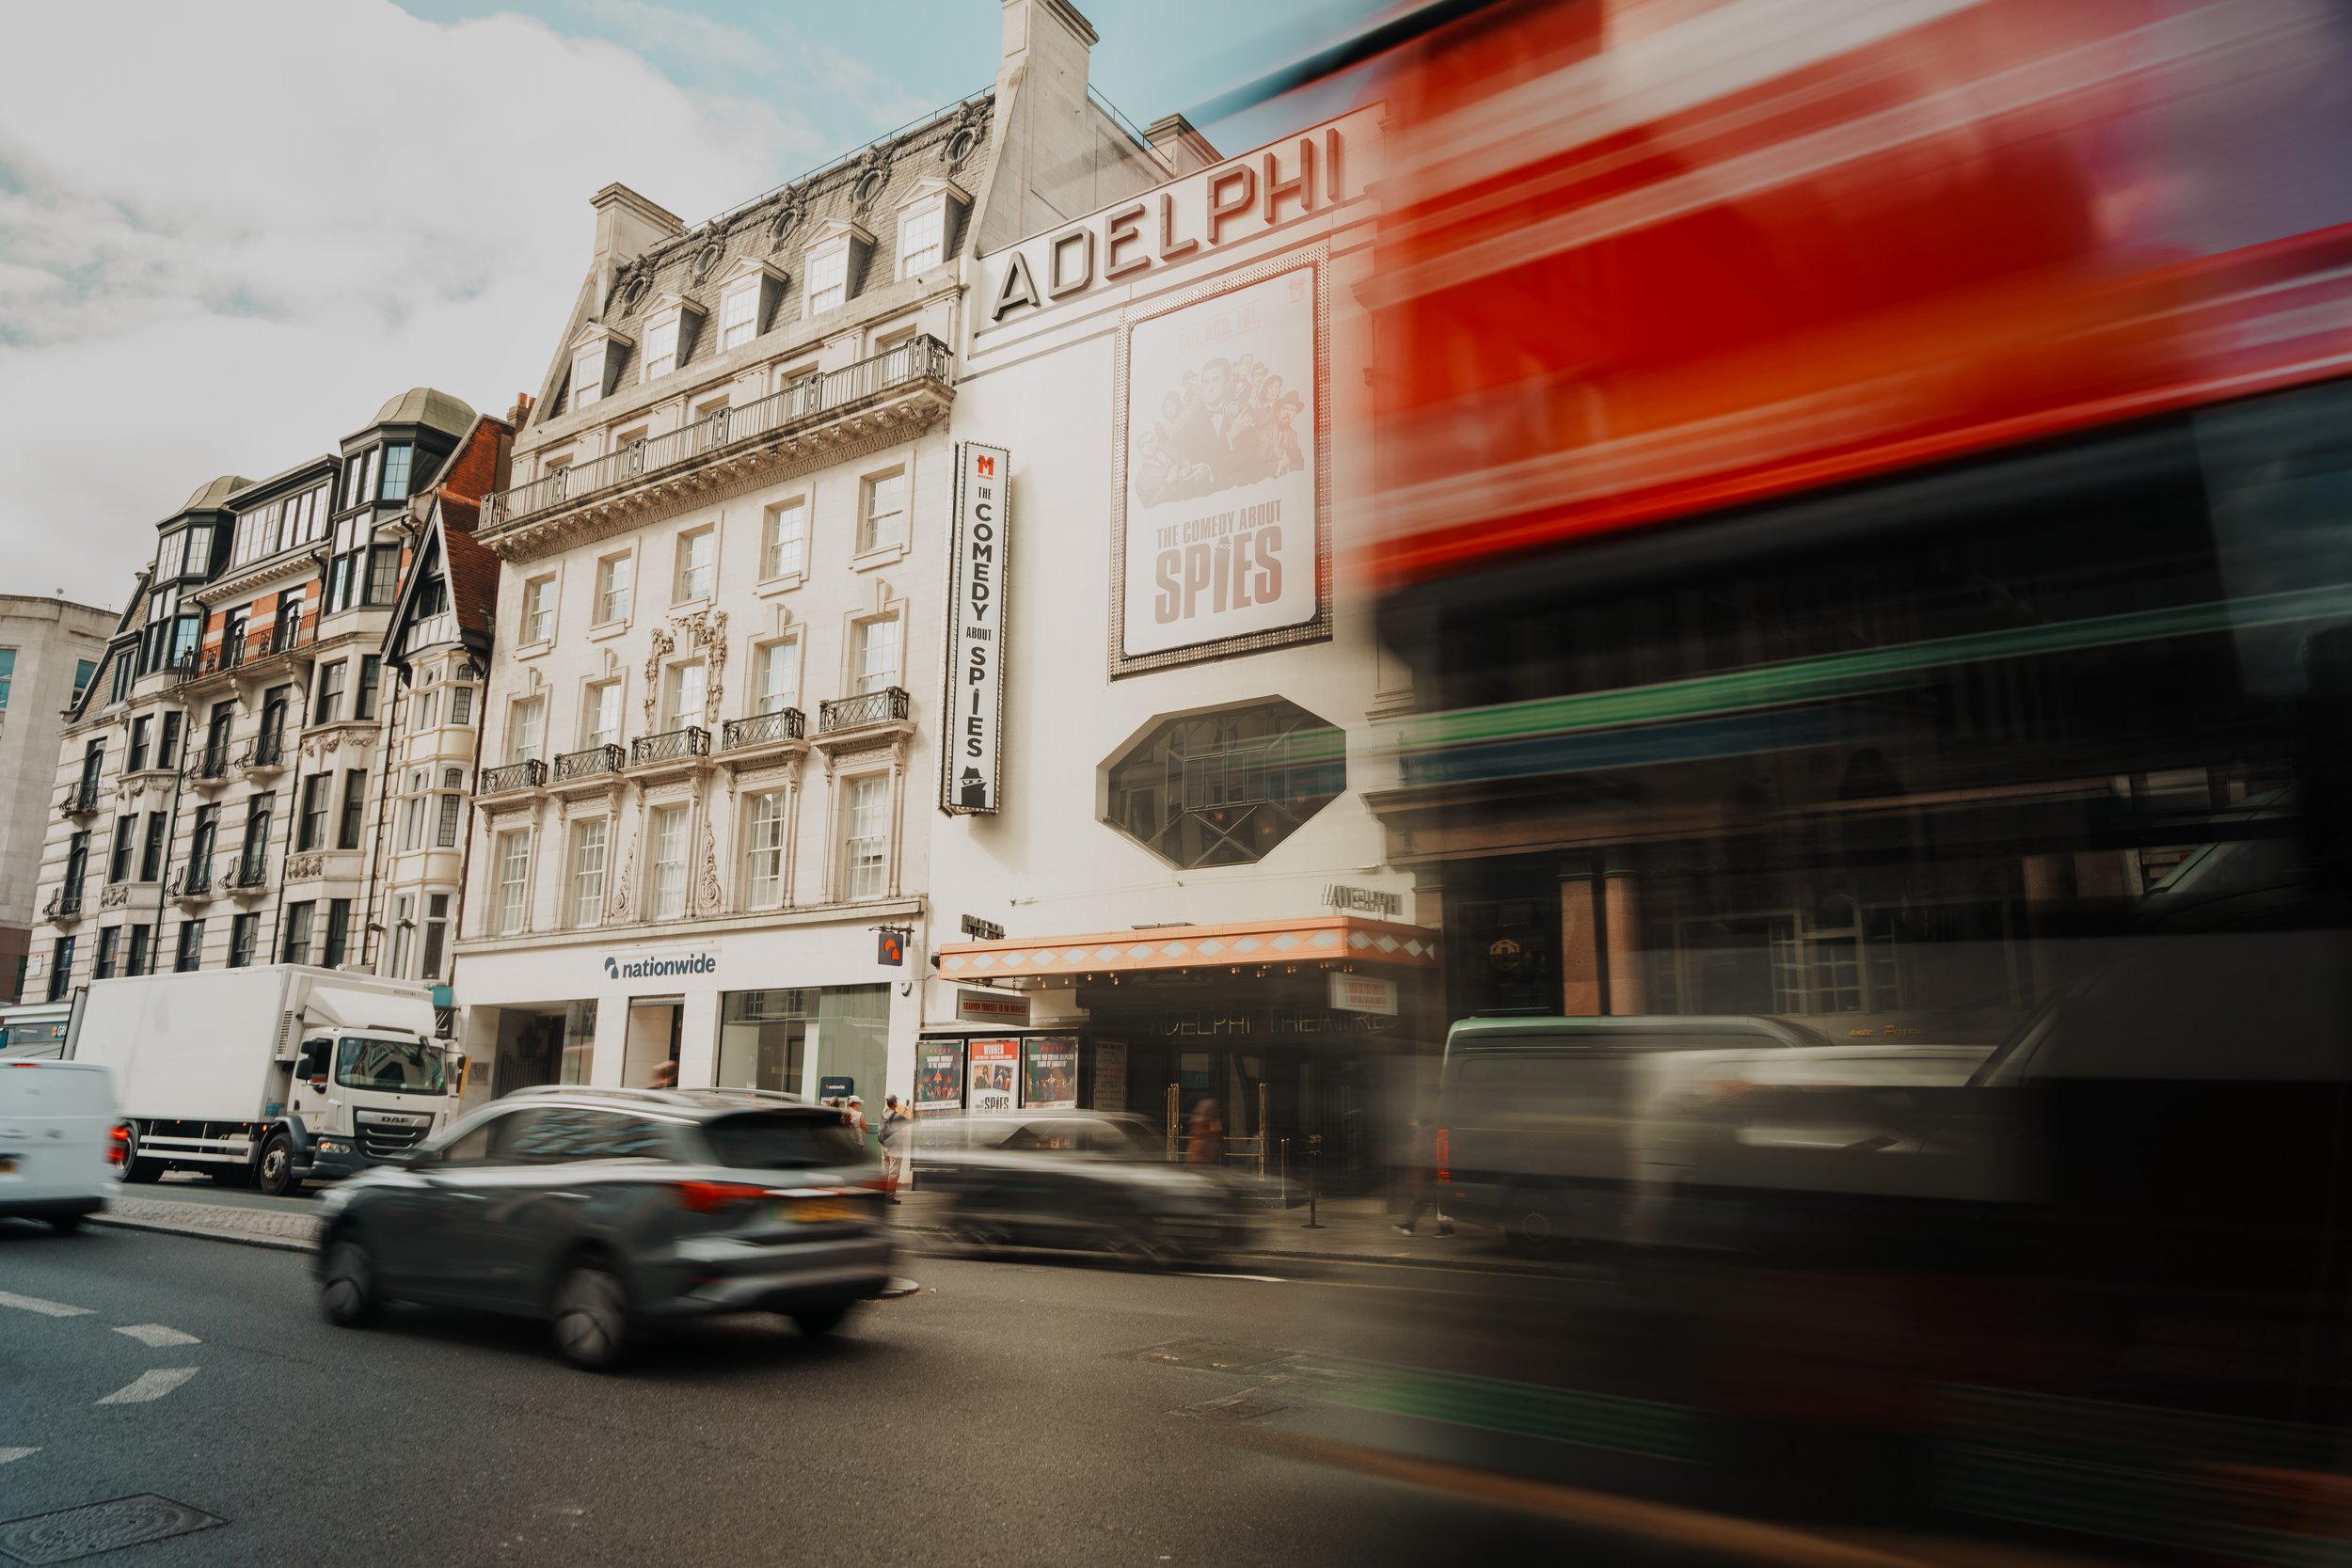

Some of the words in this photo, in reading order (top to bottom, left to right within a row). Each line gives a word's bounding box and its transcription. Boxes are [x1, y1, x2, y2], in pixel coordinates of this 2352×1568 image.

[991, 128, 1340, 322] ADELPHI
[977, 486, 992, 499] THE
[1157, 525, 1178, 549] THE
[1183, 511, 1234, 543] COMEDY
[1239, 499, 1282, 531] ABOUT
[971, 503, 993, 621] COMEDY
[1155, 525, 1282, 625] SPIES
[965, 626, 992, 641] ABOUT
[966, 646, 986, 758] SPIES
[622, 952, 716, 978] nationwide
[984, 1096, 1009, 1114] SPIES
